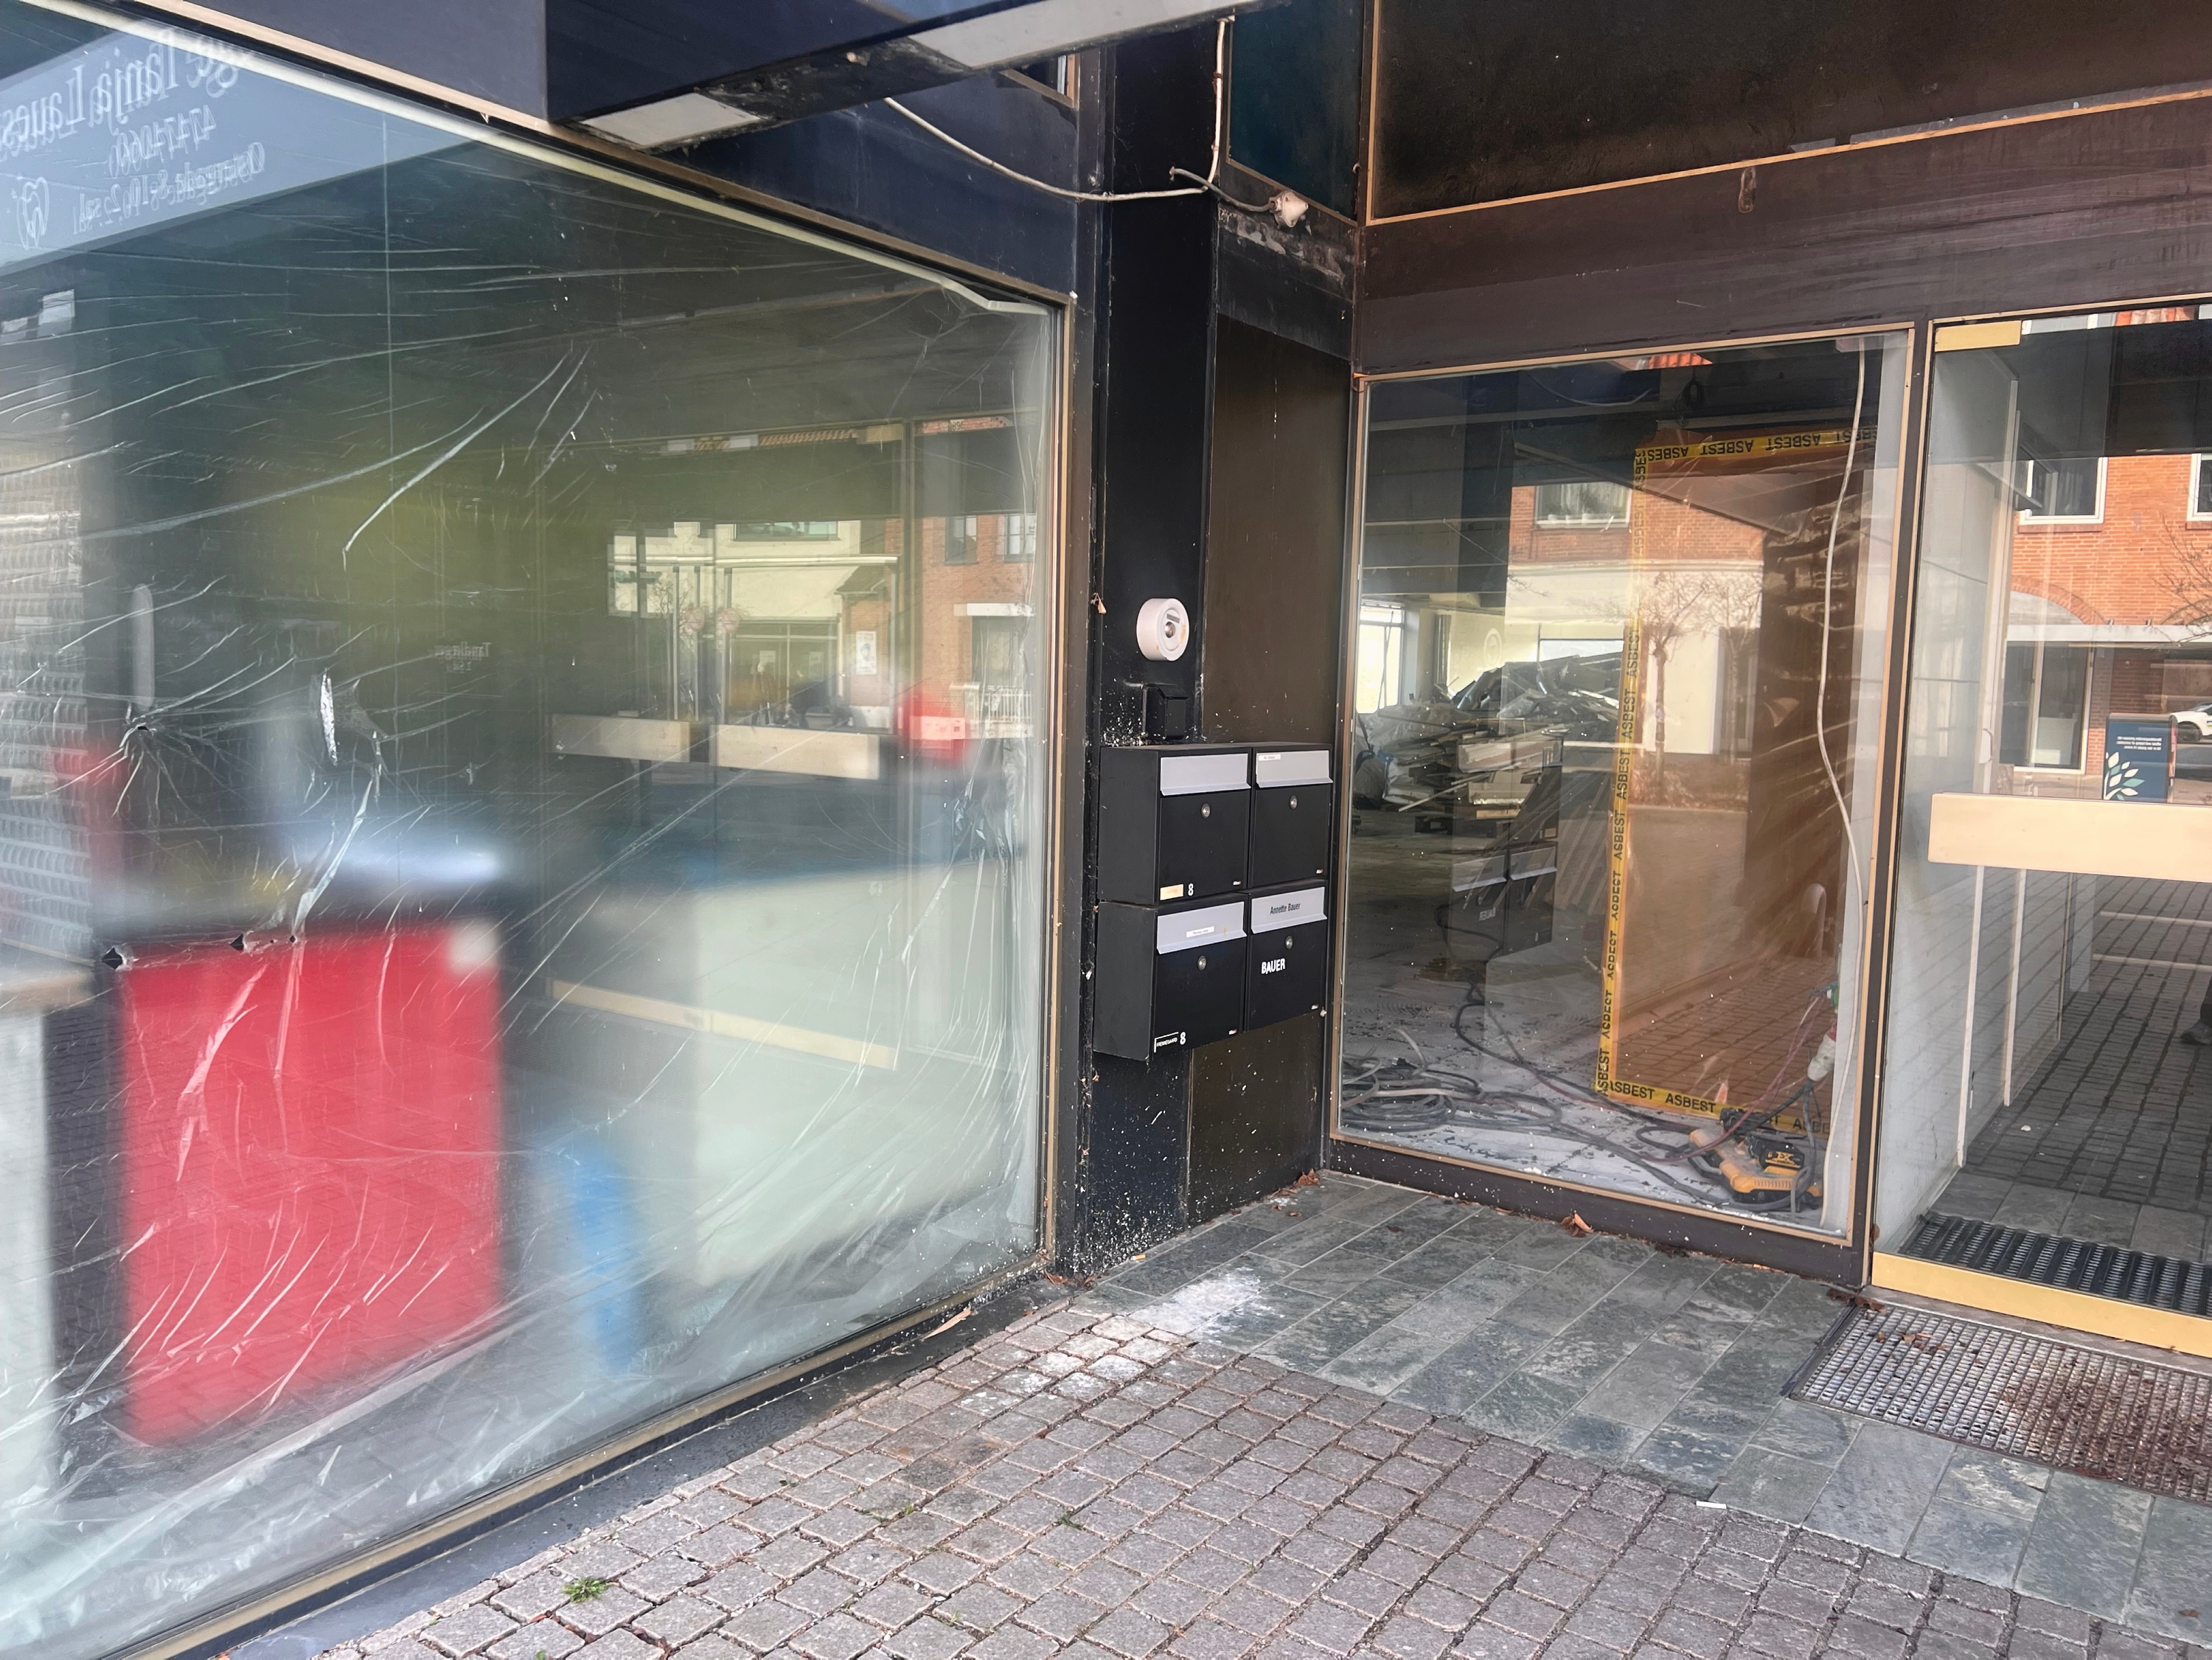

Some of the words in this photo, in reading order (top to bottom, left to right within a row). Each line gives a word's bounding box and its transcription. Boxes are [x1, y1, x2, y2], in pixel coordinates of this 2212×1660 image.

[1700, 439, 1753, 455] ASBEST
[1766, 433, 1821, 451] ASBEST
[1647, 446, 1689, 462] ASBES
[1626, 628, 1639, 678] ASBEST
[1621, 689, 1635, 740] ASBEST
[1616, 749, 1630, 799] ASBEST
[1613, 810, 1625, 861] ASBEST
[1188, 883, 1194, 896] 8
[1270, 904, 1287, 915] Annette
[1288, 903, 1301, 911] Bauer
[1261, 958, 1286, 974] BAUER
[1180, 1032, 1186, 1045] 8
[1665, 1093, 1717, 1114] ASBEST
